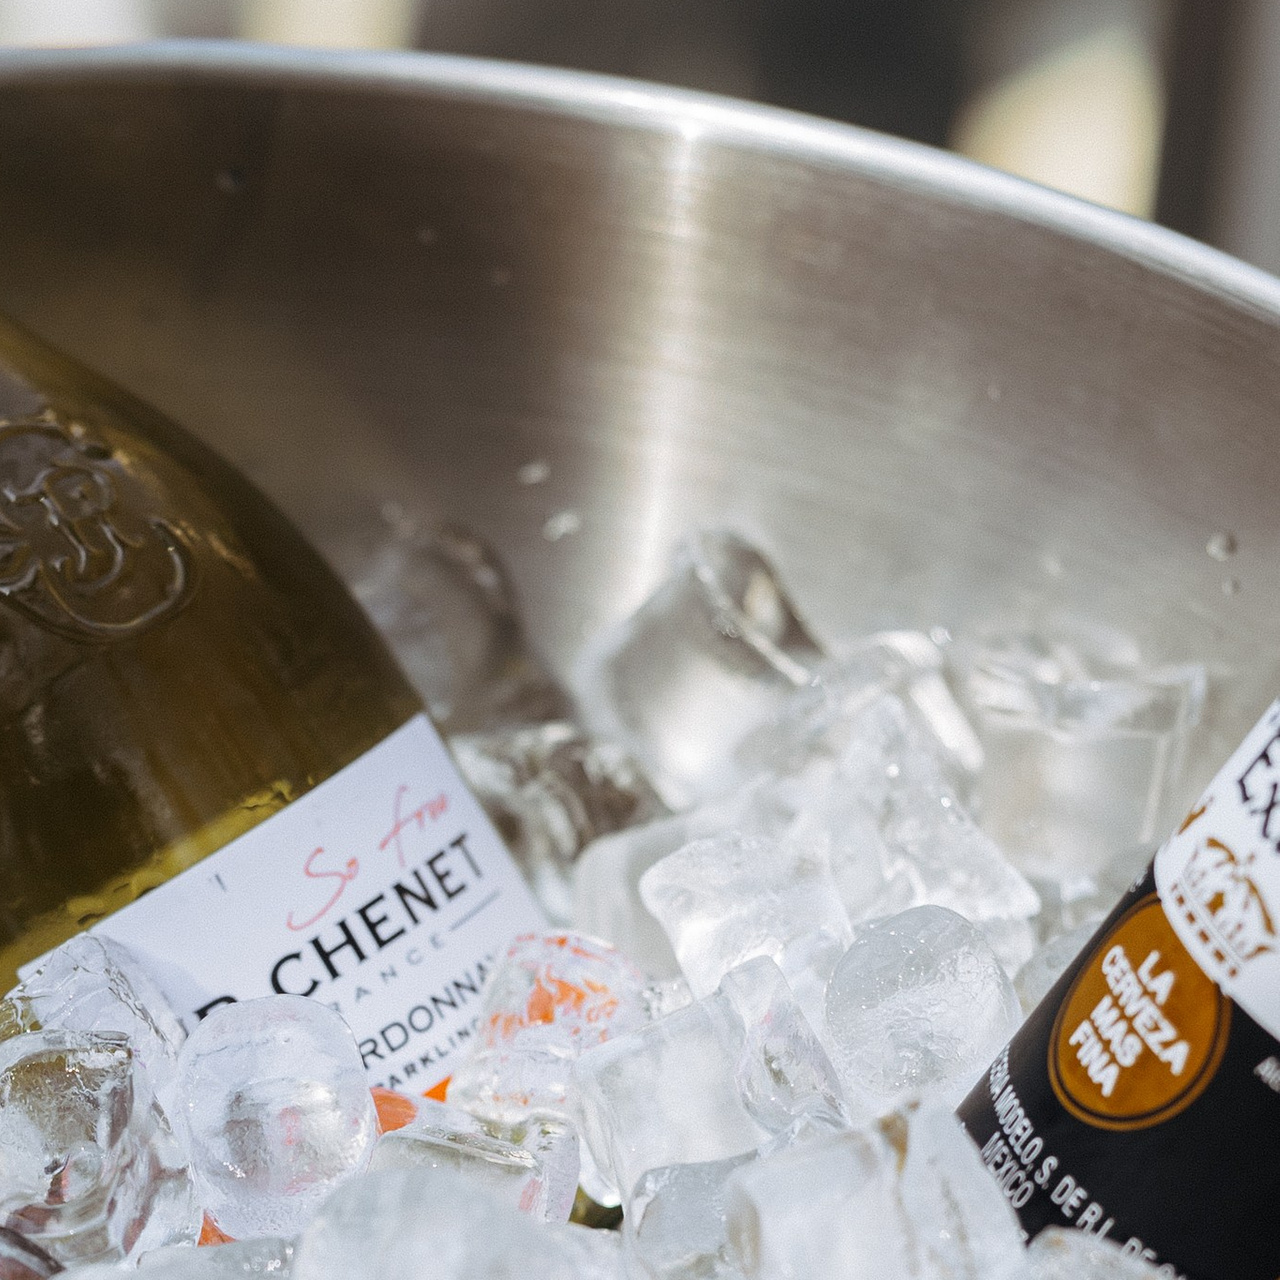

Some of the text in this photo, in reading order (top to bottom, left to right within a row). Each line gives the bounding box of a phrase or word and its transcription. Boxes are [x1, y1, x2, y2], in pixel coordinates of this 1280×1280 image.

[270, 832, 483, 996] CHENET
[286, 846, 360, 931] So
[1101, 944, 1190, 1077] CERVEZA
[1137, 949, 1176, 1006] LA
[1068, 1019, 1120, 1098] FINA
[1090, 995, 1142, 1068] MAS
[981, 1130, 1034, 1209] MEXICO
[1050, 1174, 1088, 1218] DE
